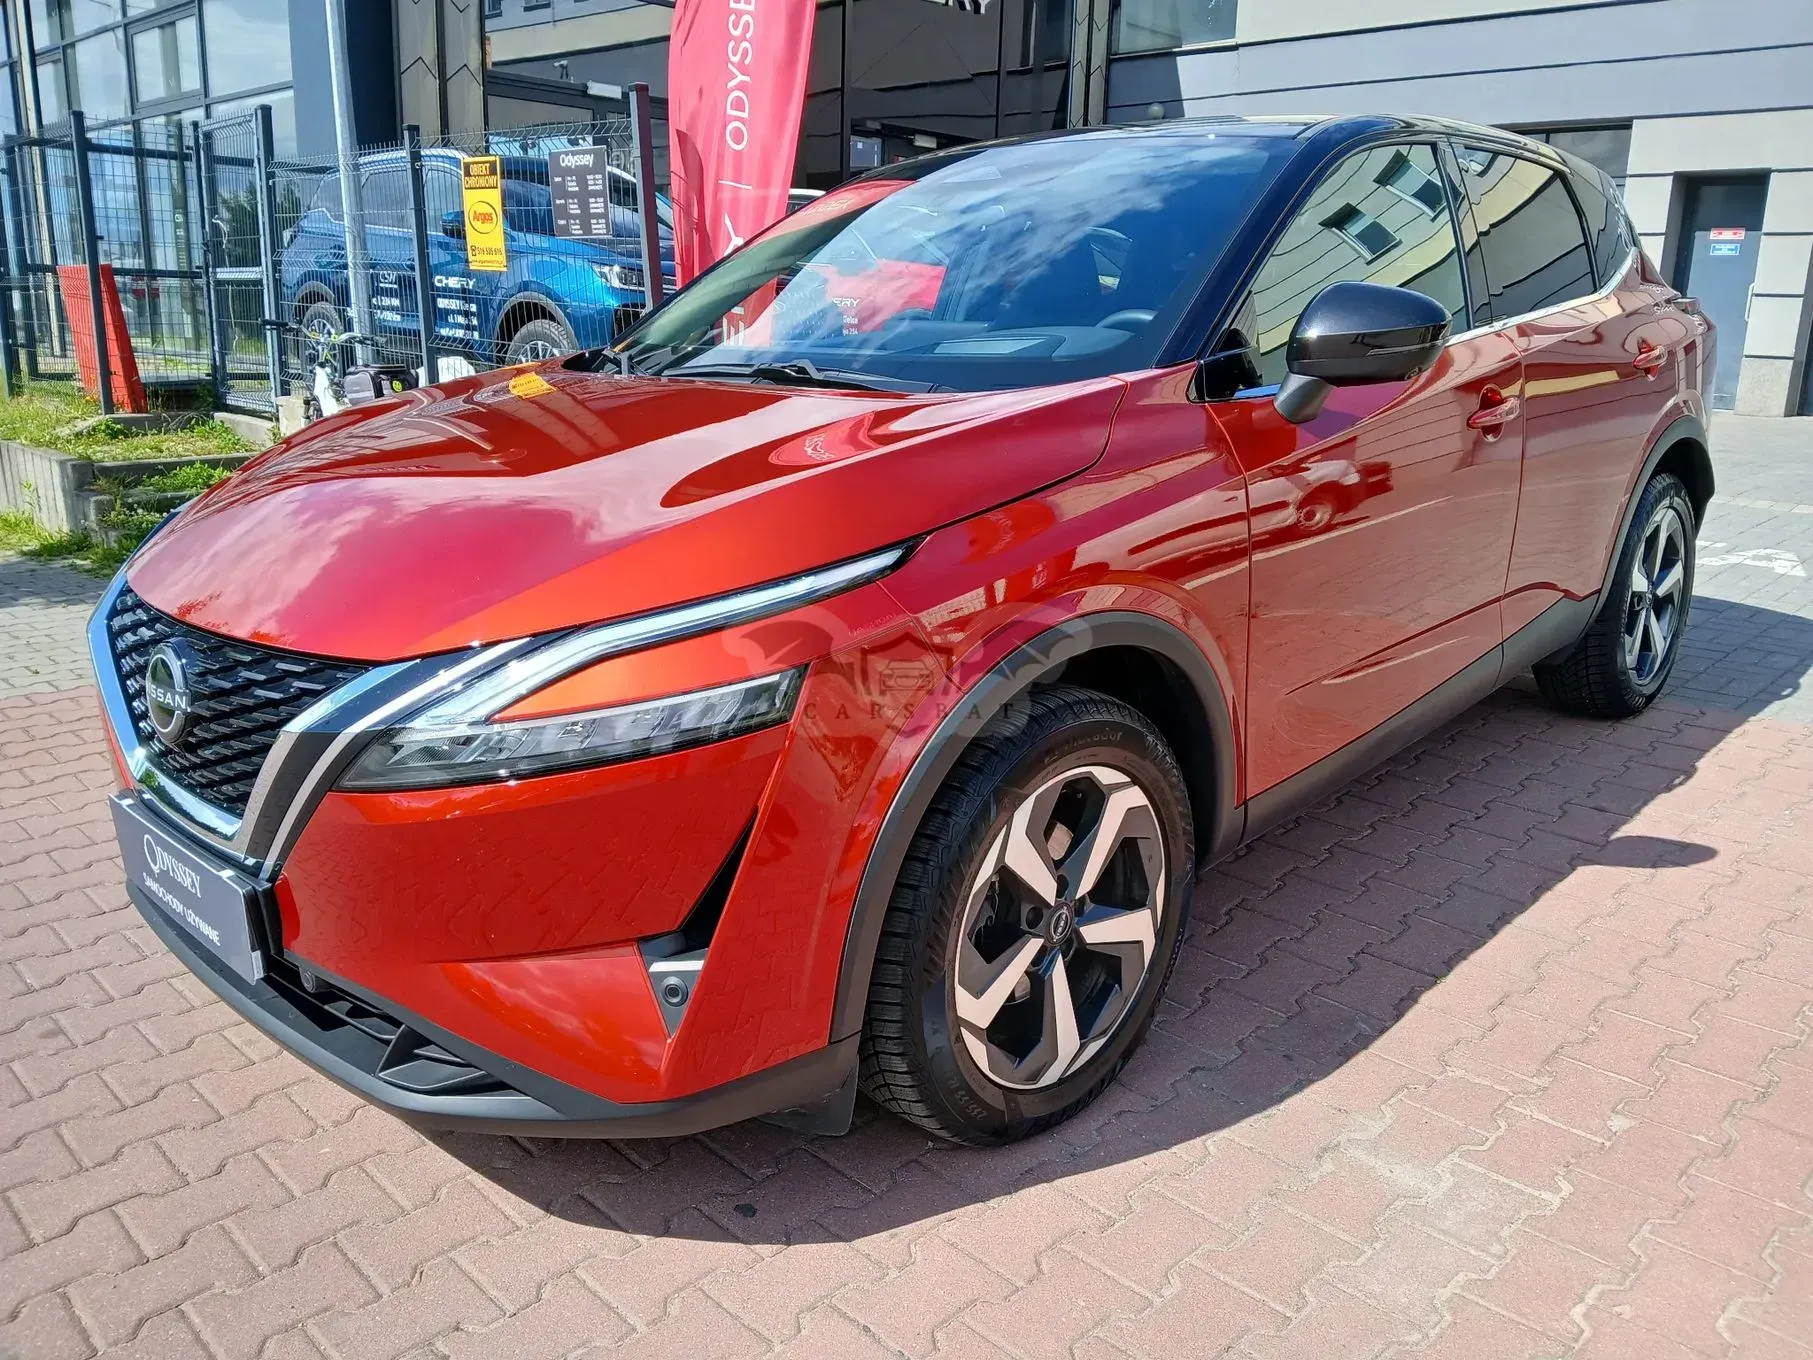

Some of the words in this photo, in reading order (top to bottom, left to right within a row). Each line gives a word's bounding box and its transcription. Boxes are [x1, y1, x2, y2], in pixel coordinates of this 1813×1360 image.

[559, 153, 594, 168] Odyssey
[469, 163, 490, 175] OBIEKT
[472, 210, 493, 224] Argos
[143, 872, 184, 917] SAMOCHODY
